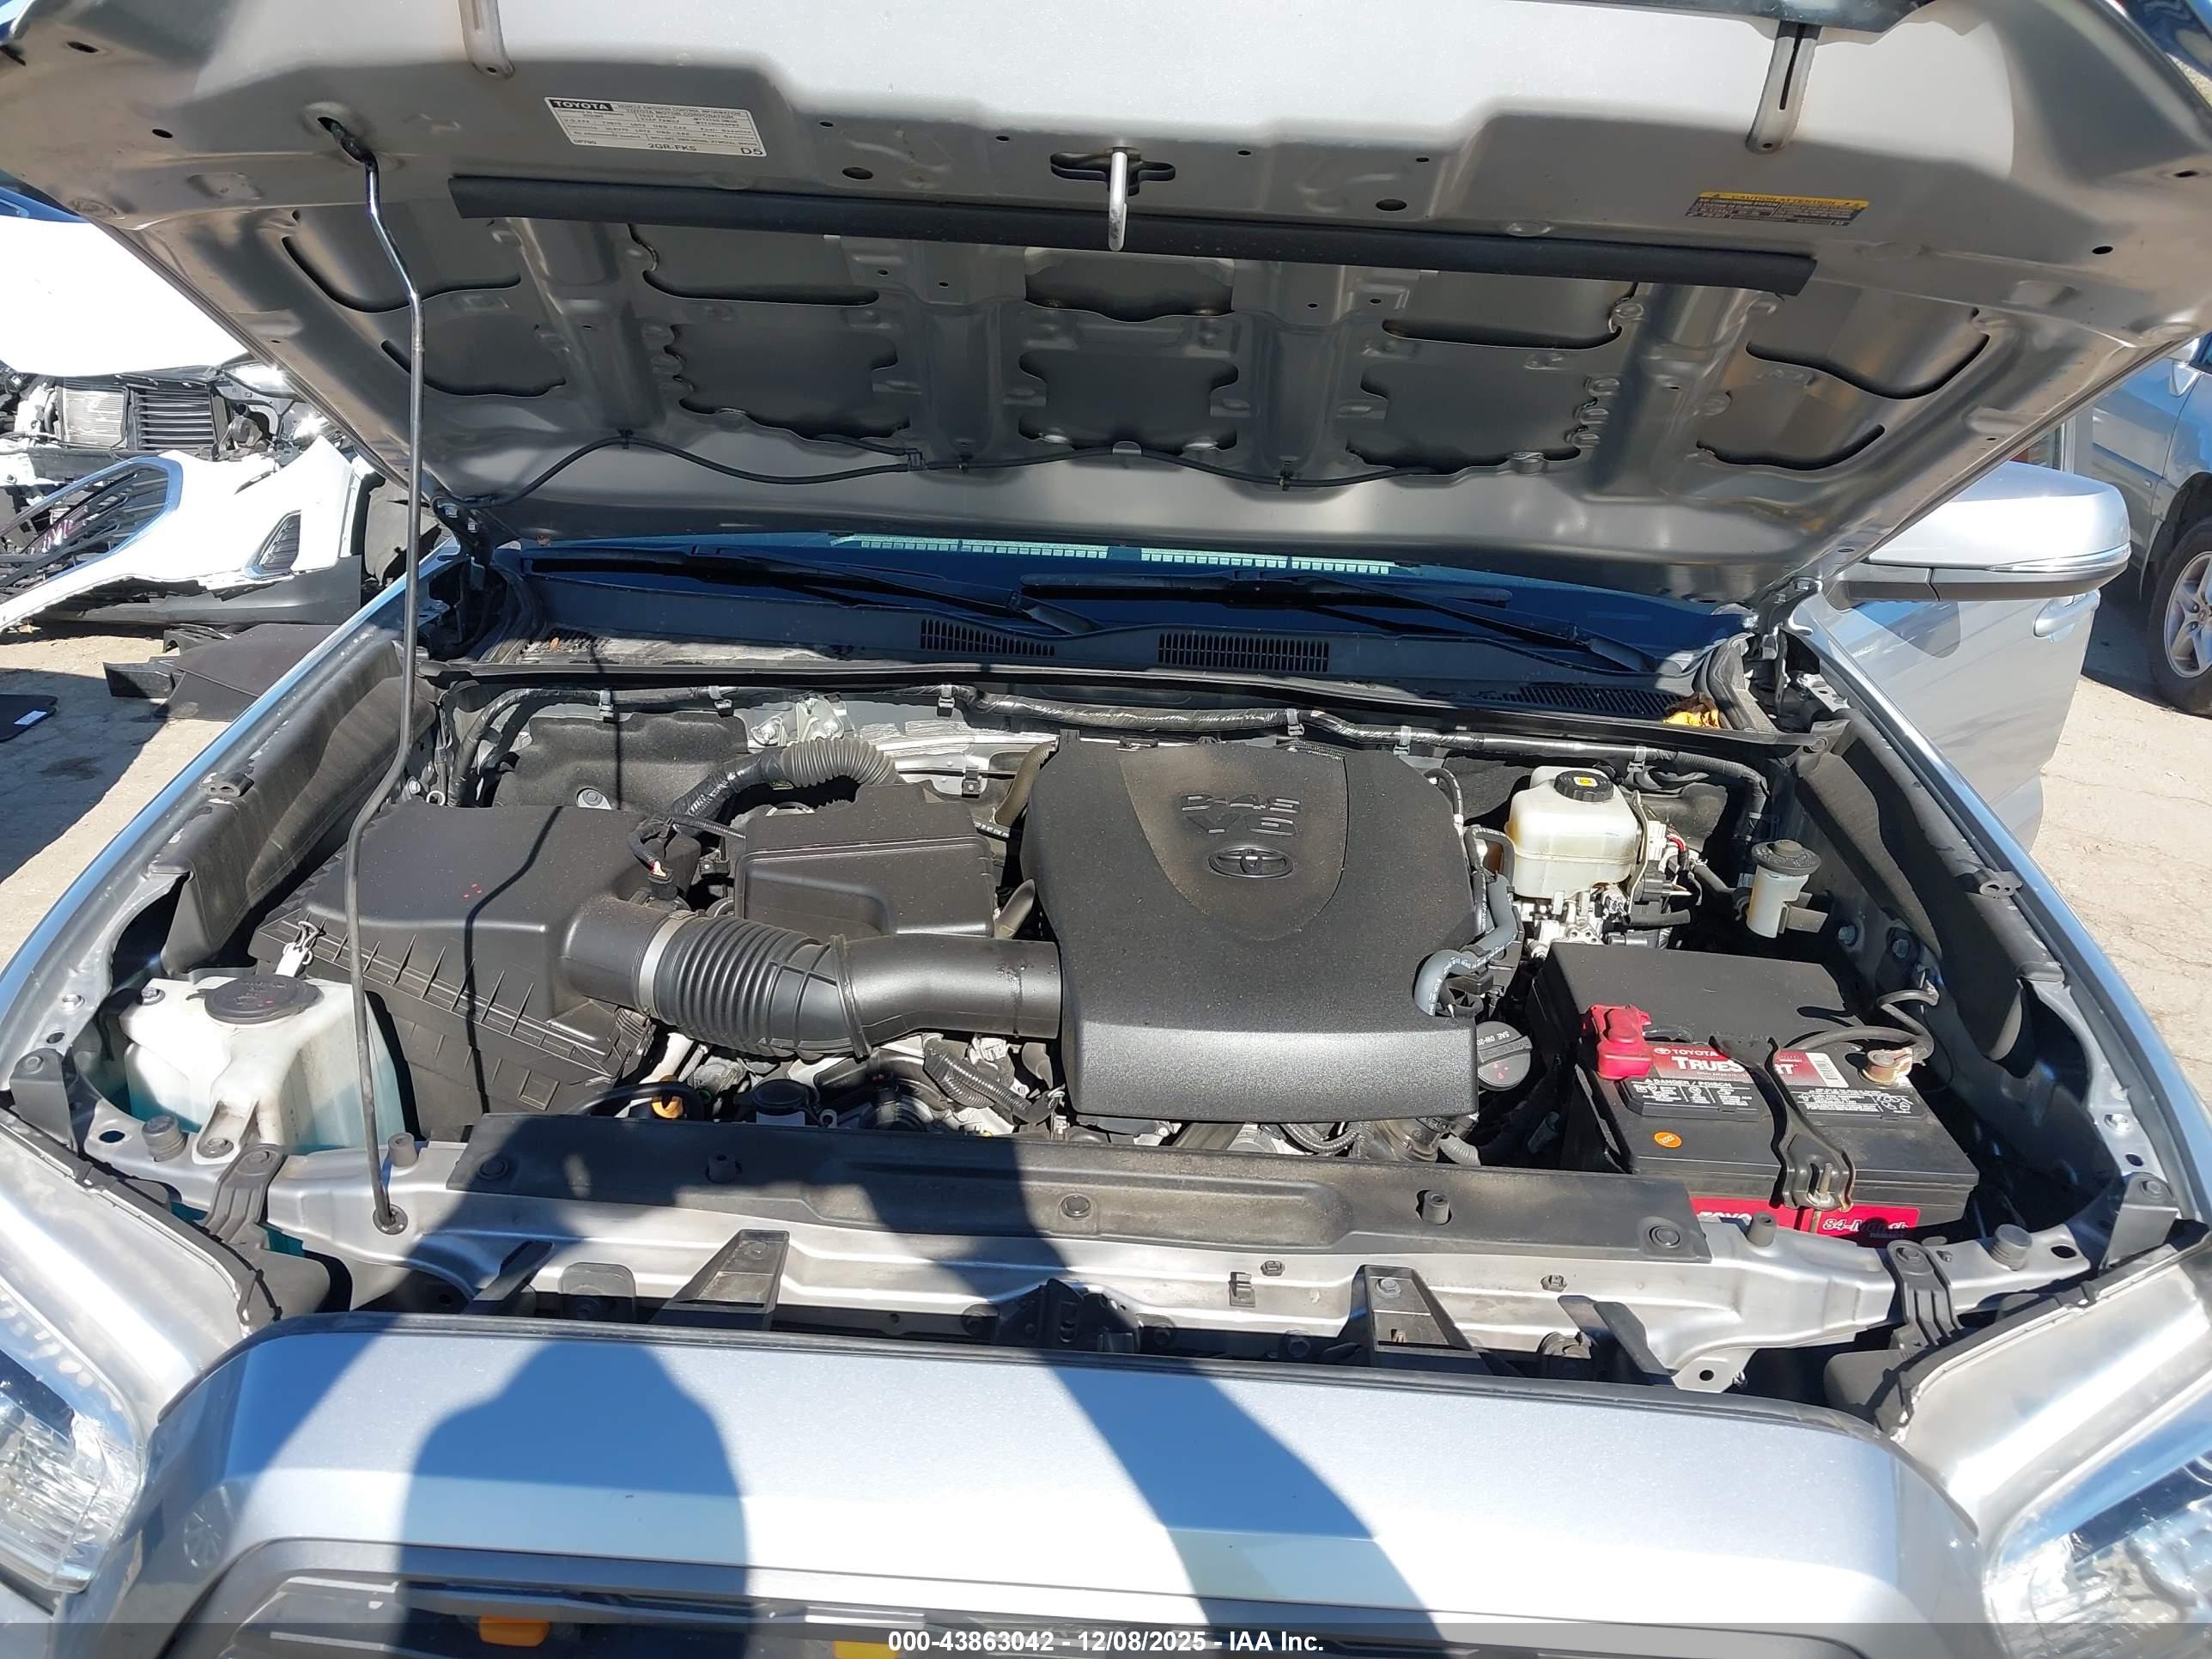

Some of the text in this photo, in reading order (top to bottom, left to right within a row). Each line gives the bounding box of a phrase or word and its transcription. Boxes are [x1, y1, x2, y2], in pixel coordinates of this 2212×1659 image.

[553, 100, 608, 111] TOYOTA
[647, 143, 697, 152] 2GR-FKS
[740, 147, 763, 155] D5
[1497, 1031, 1510, 1040] SAE
[1671, 1048, 1719, 1057] TOYOTA
[1653, 1078, 1691, 1086] DANGER
